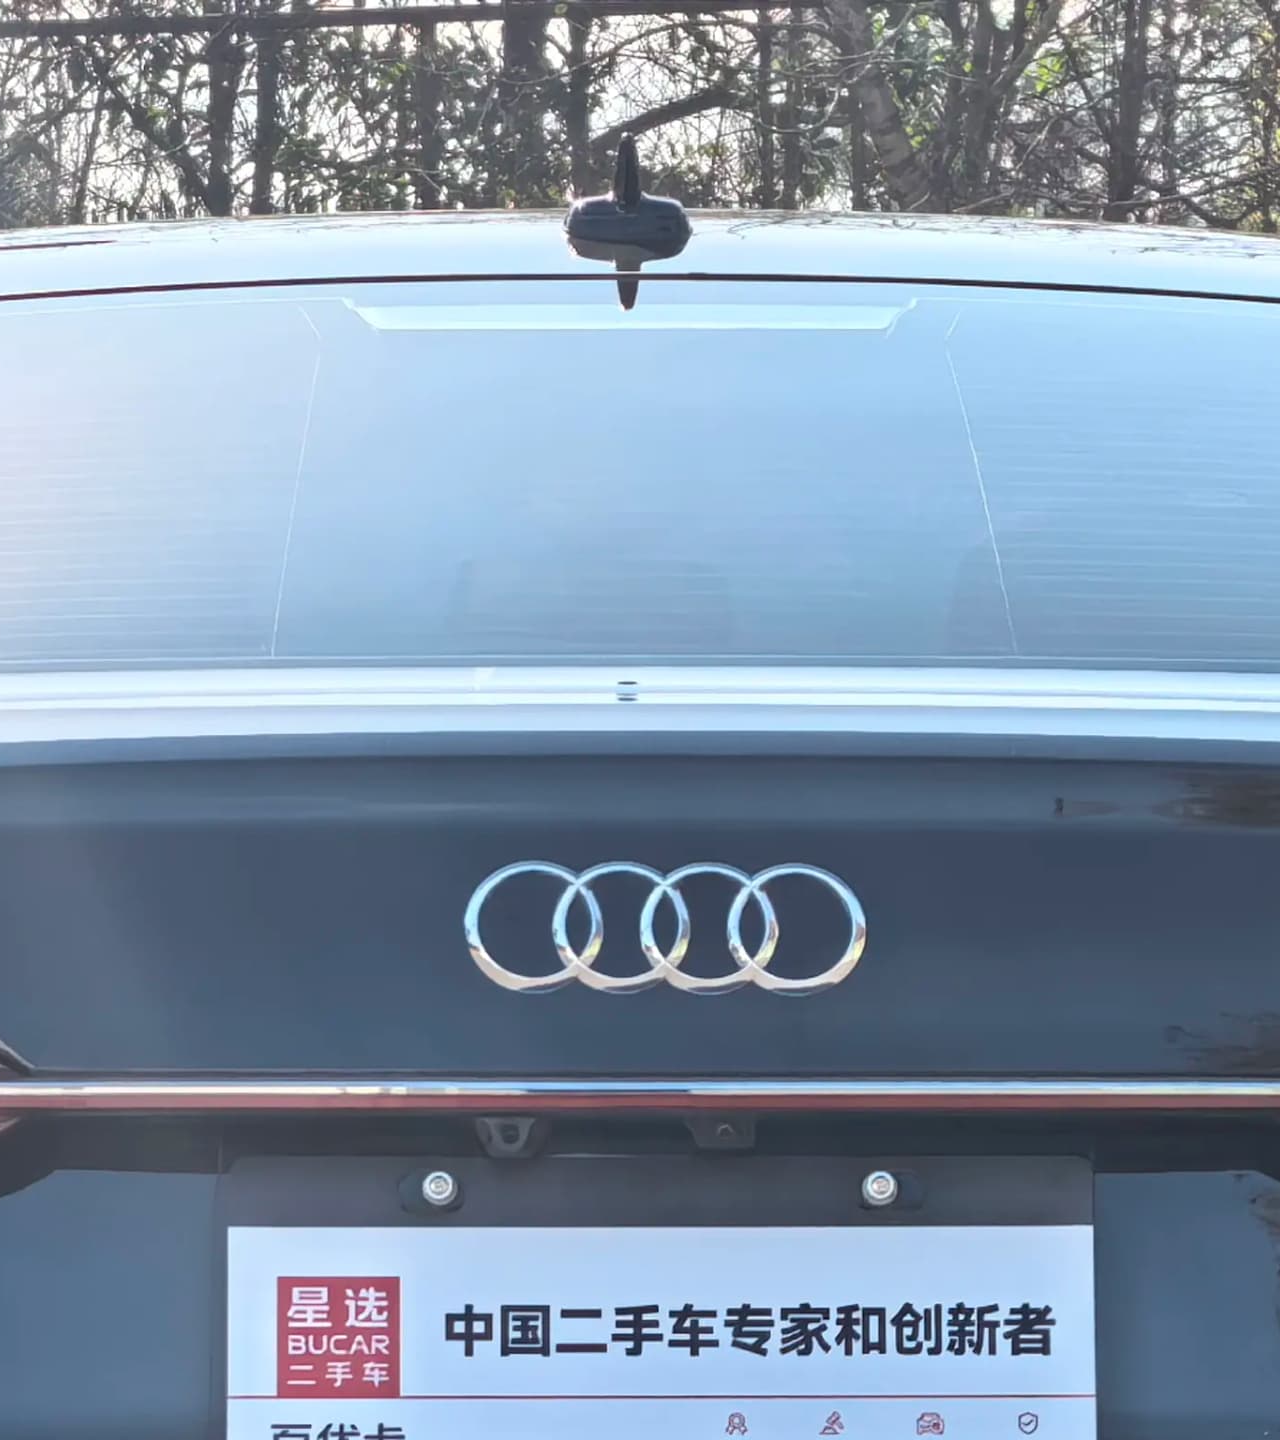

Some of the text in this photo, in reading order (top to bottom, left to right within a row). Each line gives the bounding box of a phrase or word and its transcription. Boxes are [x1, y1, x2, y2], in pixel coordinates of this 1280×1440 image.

[287, 1286, 389, 1328] 星选
[287, 1334, 390, 1355] BUCAR
[444, 1303, 1057, 1357] 中国二手车专家和创新者
[286, 1361, 390, 1388] 二手车
